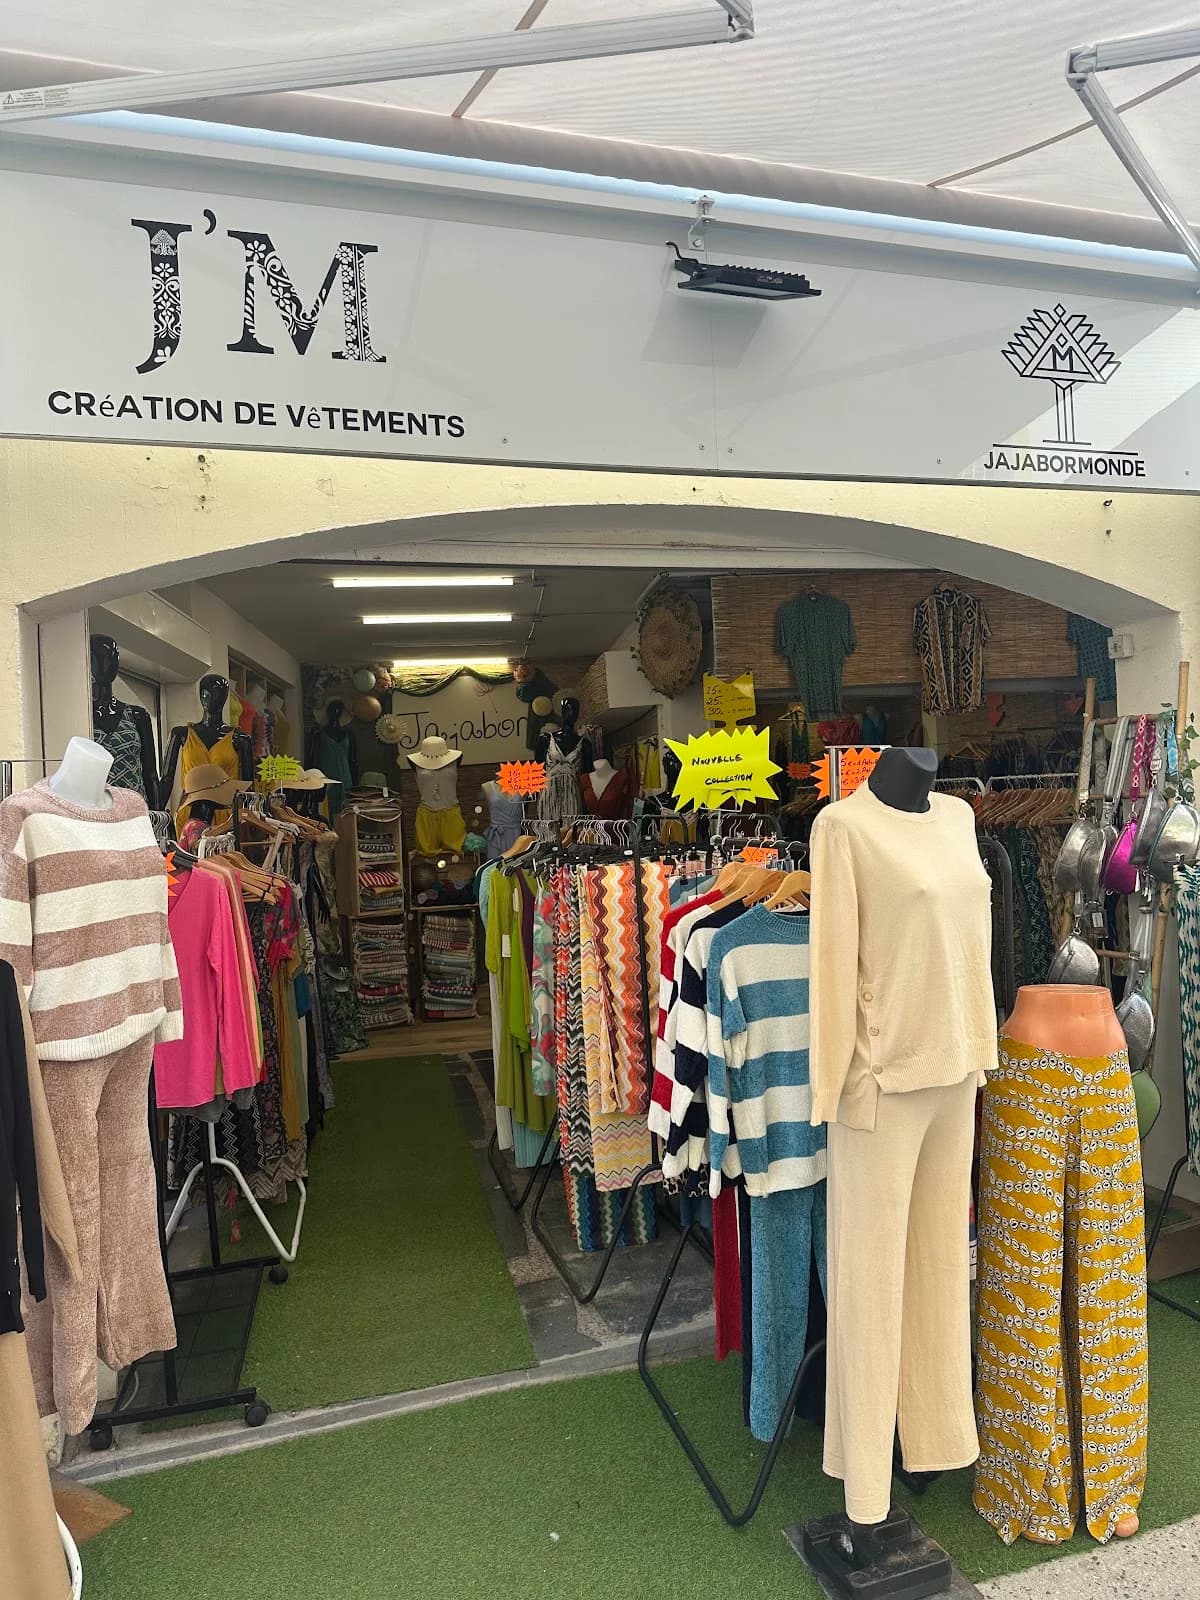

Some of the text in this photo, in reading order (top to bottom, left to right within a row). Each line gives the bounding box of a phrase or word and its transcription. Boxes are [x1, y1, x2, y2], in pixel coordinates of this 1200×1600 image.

[48, 390, 465, 438] CRéATION DE VêTEMENTS
[984, 451, 1146, 477] JAJABORMONDE
[704, 772, 753, 786] COLLECTION
